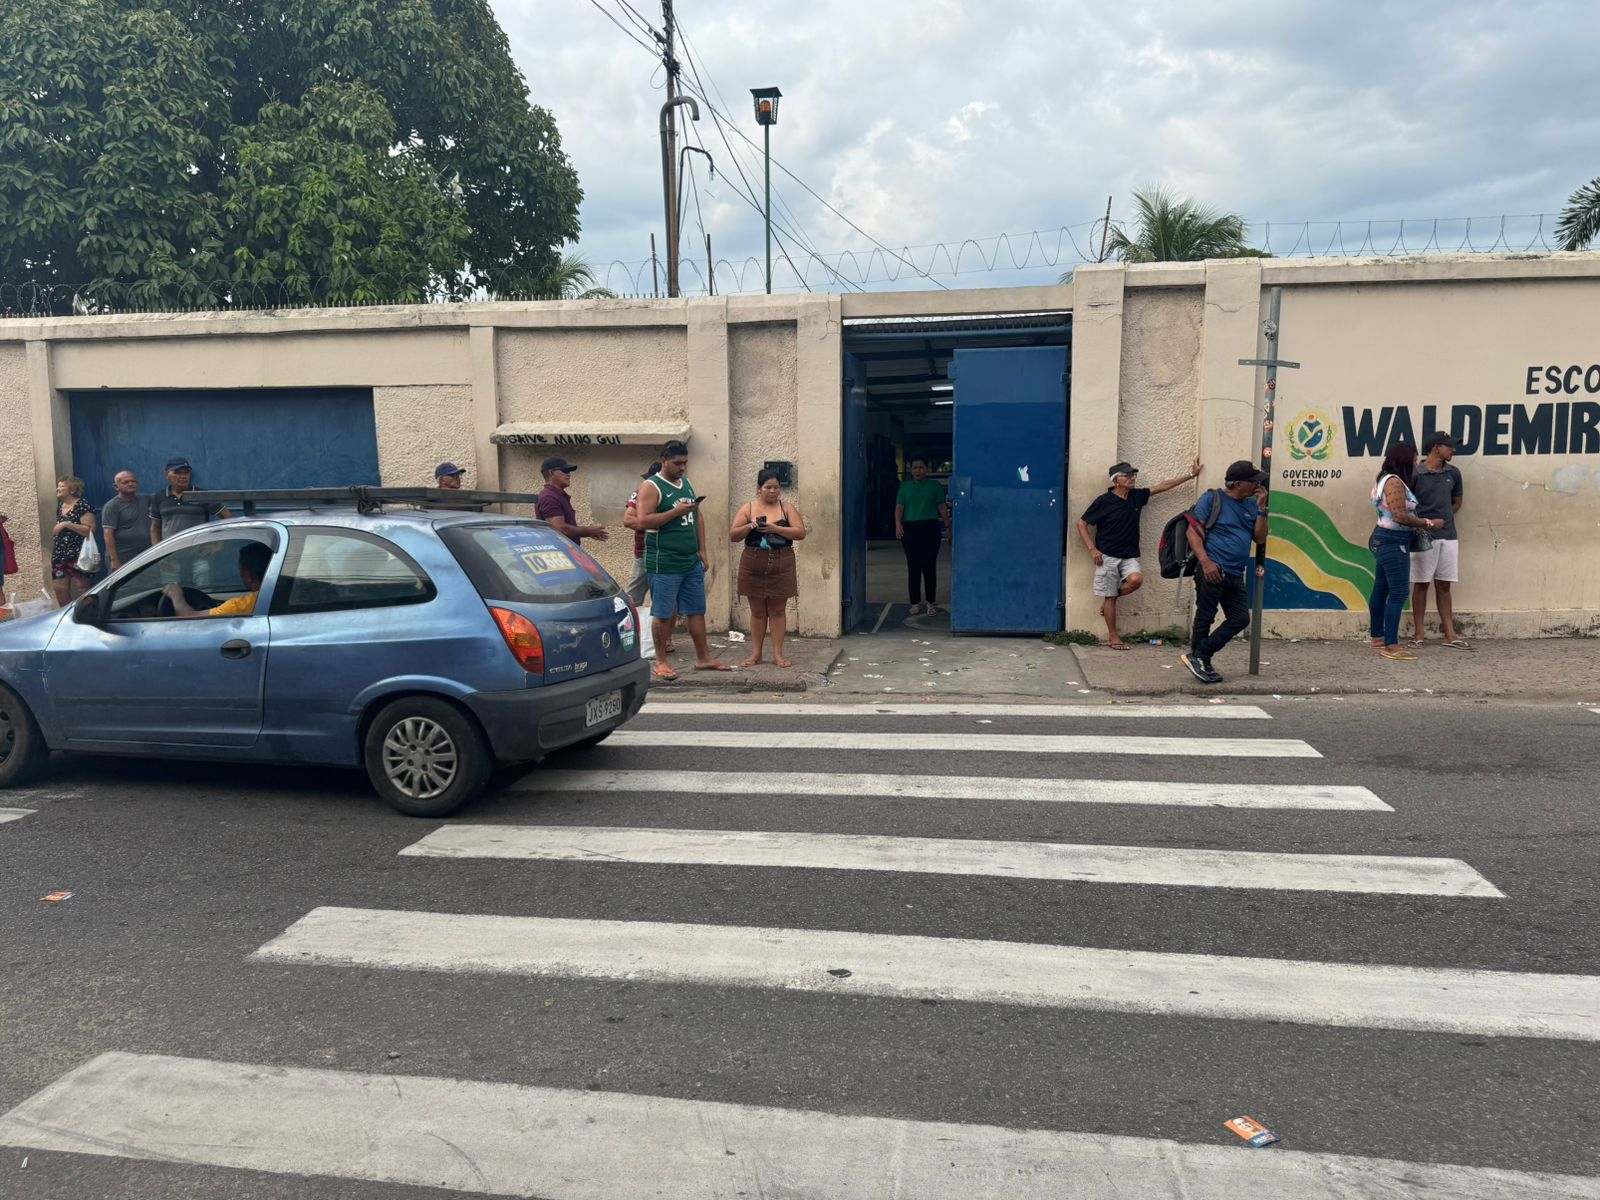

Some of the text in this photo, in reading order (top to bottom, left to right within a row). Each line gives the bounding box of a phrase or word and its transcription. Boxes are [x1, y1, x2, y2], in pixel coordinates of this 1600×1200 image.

[1526, 365, 1600, 394] ESCO
[1282, 469, 1342, 479] GOVERNO DO
[1291, 479, 1324, 488] ESTADO
